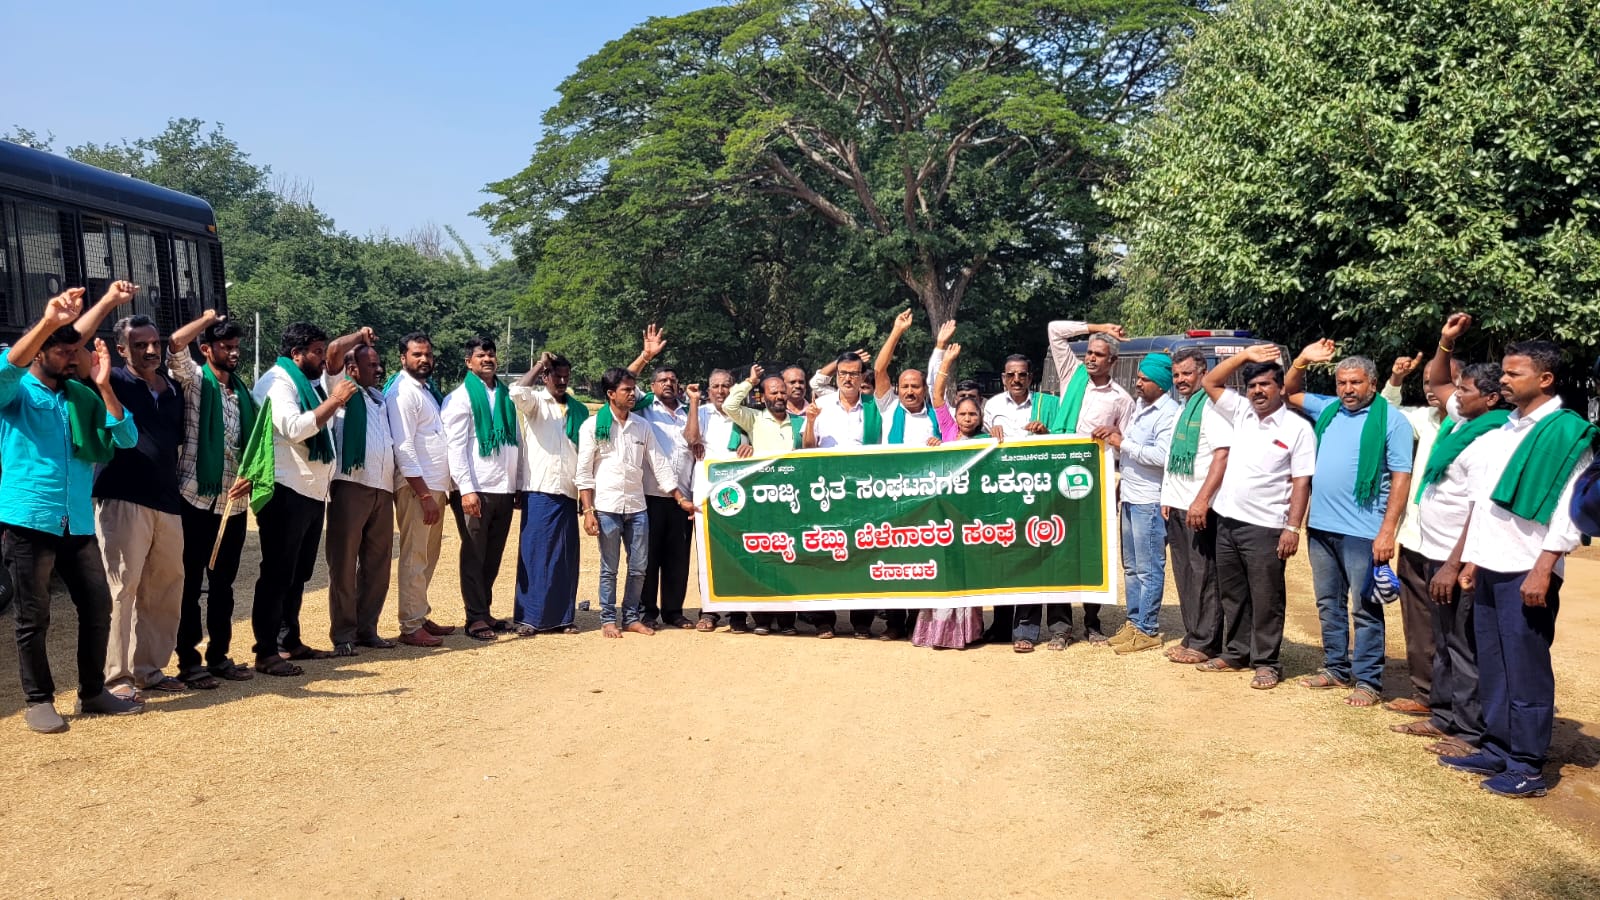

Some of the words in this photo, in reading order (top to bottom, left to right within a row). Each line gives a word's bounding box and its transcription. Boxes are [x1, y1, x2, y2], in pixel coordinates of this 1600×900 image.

[752, 482, 801, 514] ರಾಜ್ಯ
[810, 475, 846, 512] ರೈತ
[856, 470, 970, 502] ಸಂಘಟನೆಗಳ
[981, 467, 1052, 504] ಒಕ್ಕೂಟ
[743, 531, 795, 563] ರಾಜ್ಯ
[803, 525, 848, 561] ಕಬ್ಬು
[855, 518, 954, 550] ಬೆಳೆಗಾರರ
[962, 517, 1016, 547] ಸಂಘ
[1025, 514, 1066, 546] (ರಿ)
[870, 559, 937, 581] ಕರ್ನಾಟಕ
